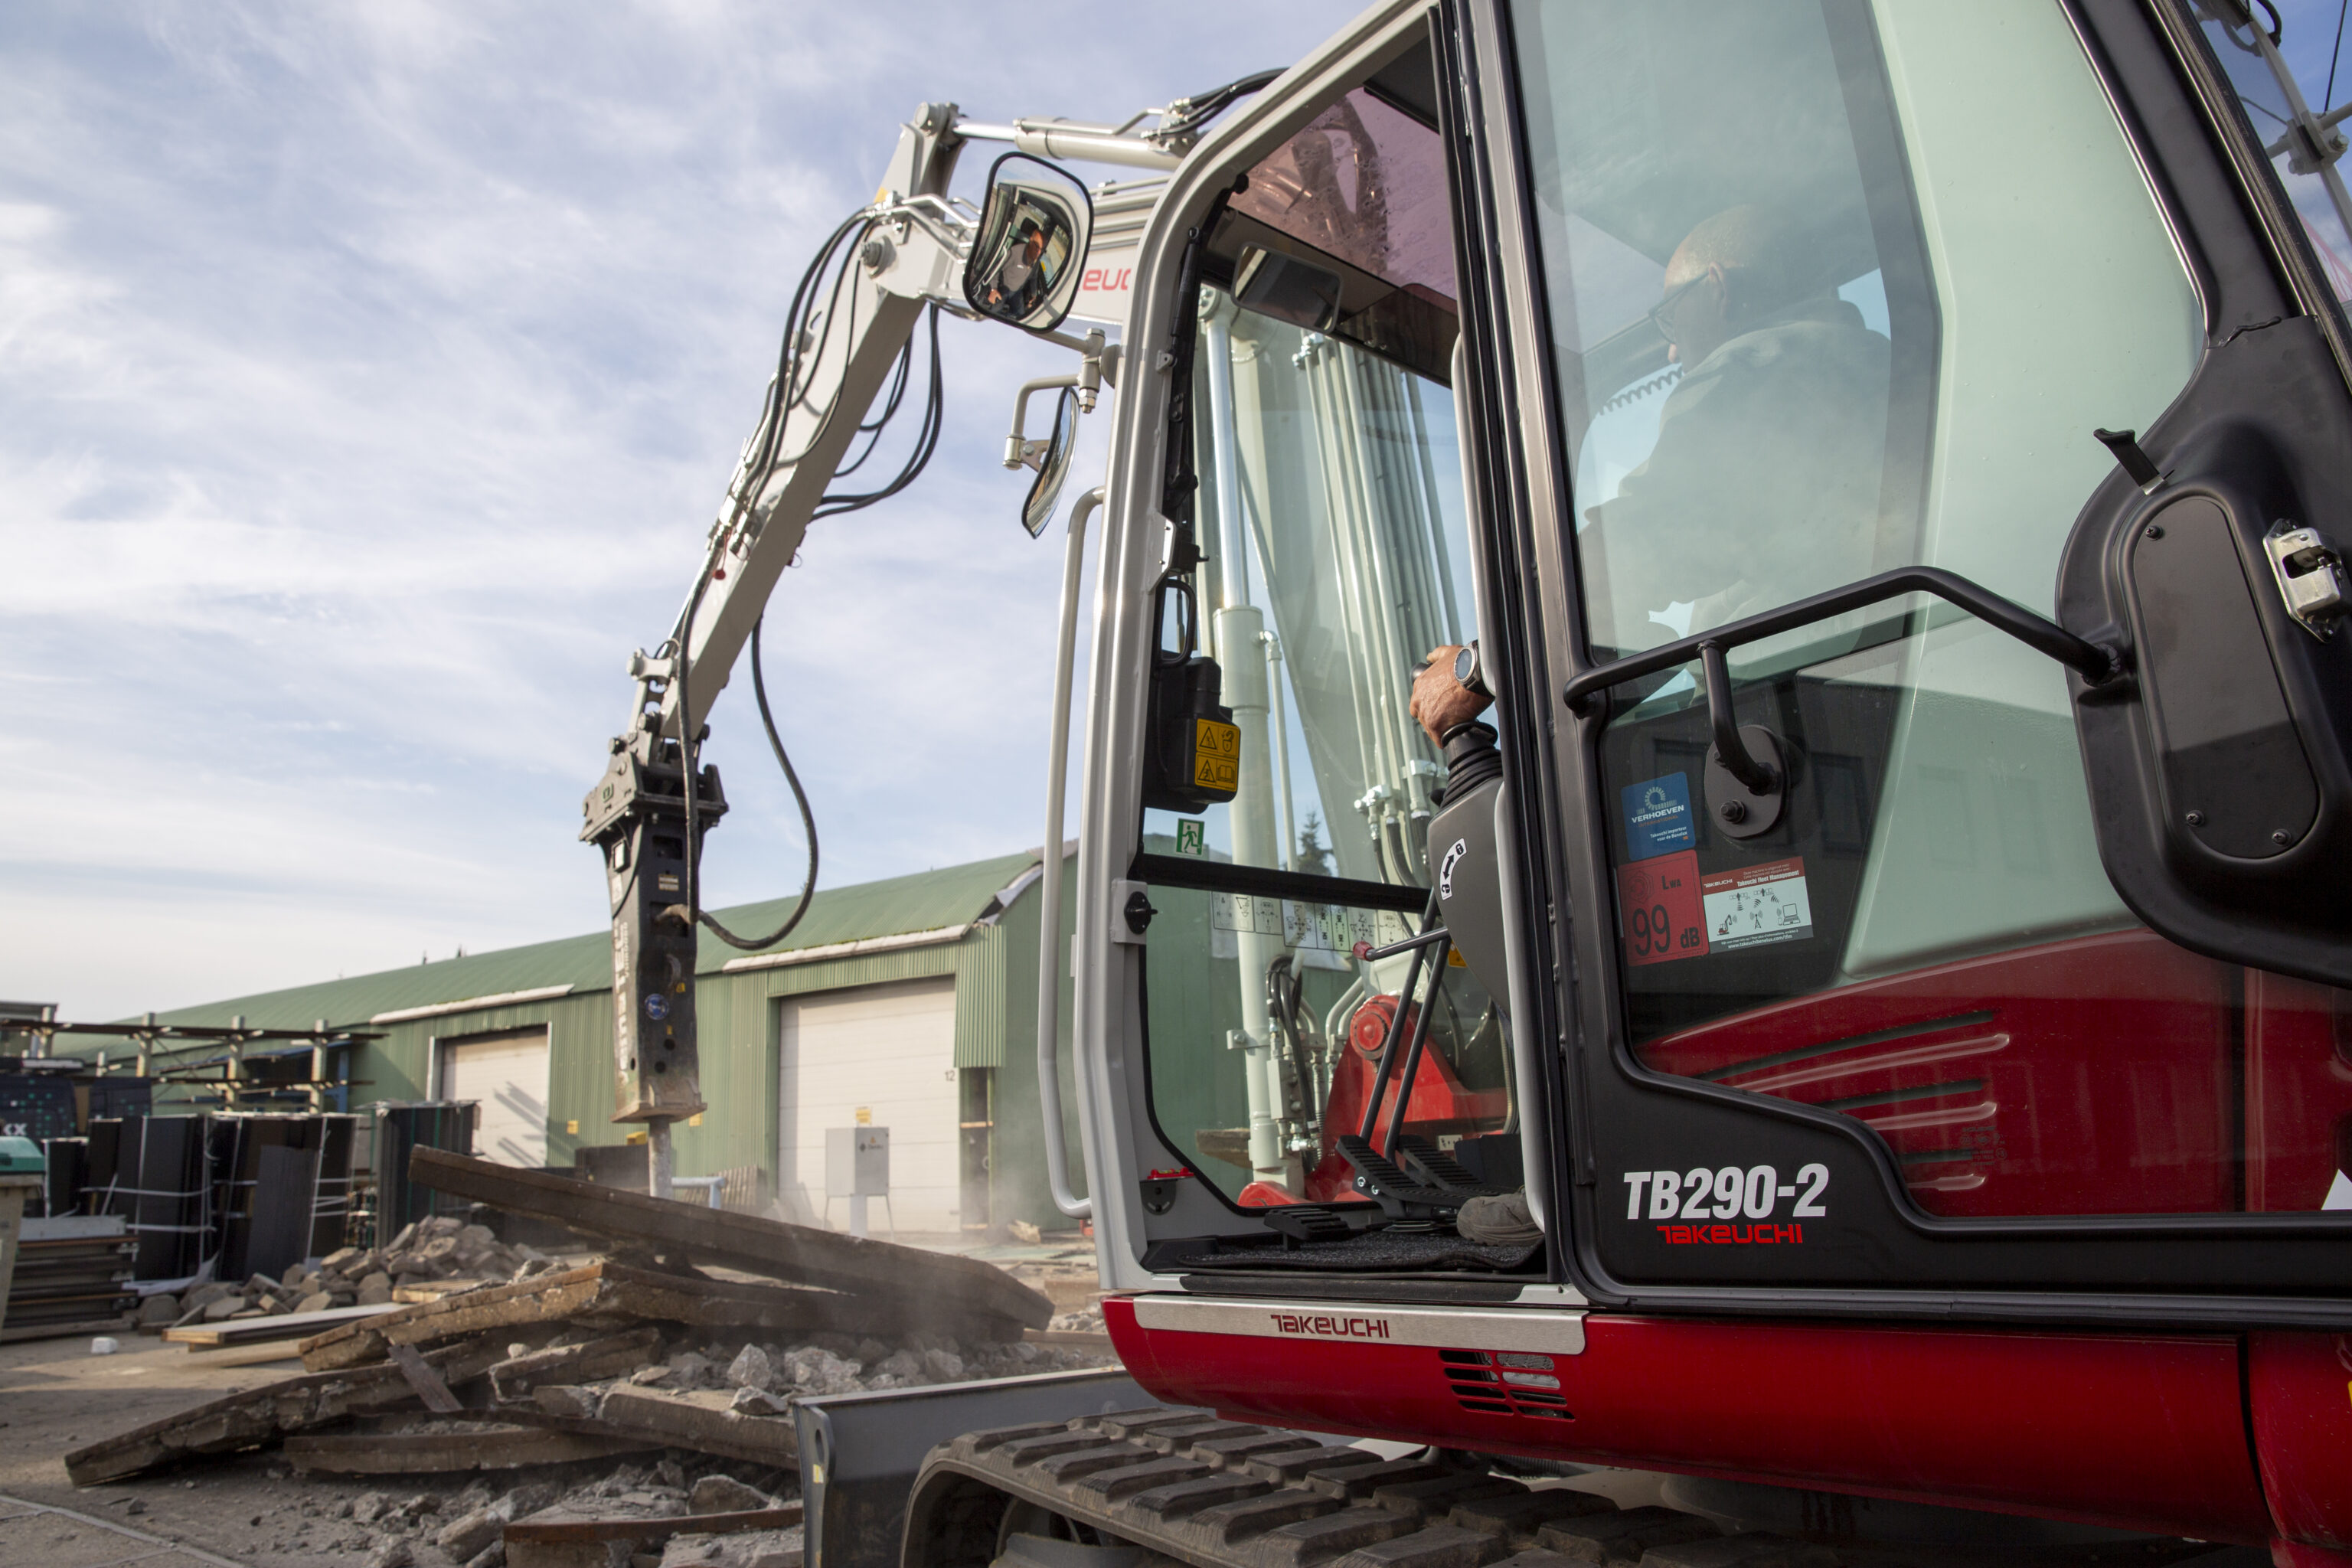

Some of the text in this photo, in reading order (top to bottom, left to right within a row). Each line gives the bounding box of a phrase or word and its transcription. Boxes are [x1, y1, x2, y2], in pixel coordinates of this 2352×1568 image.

[1632, 805, 1684, 823] VERHOEVEN
[1638, 815, 1678, 827] INTERNATIONAL
[1737, 878, 1757, 887] Takeuchi
[1769, 870, 1799, 880] Management
[1632, 904, 1700, 956] 99 dB
[945, 1070, 956, 1081] 12
[1623, 1163, 1829, 1220] TB290-2
